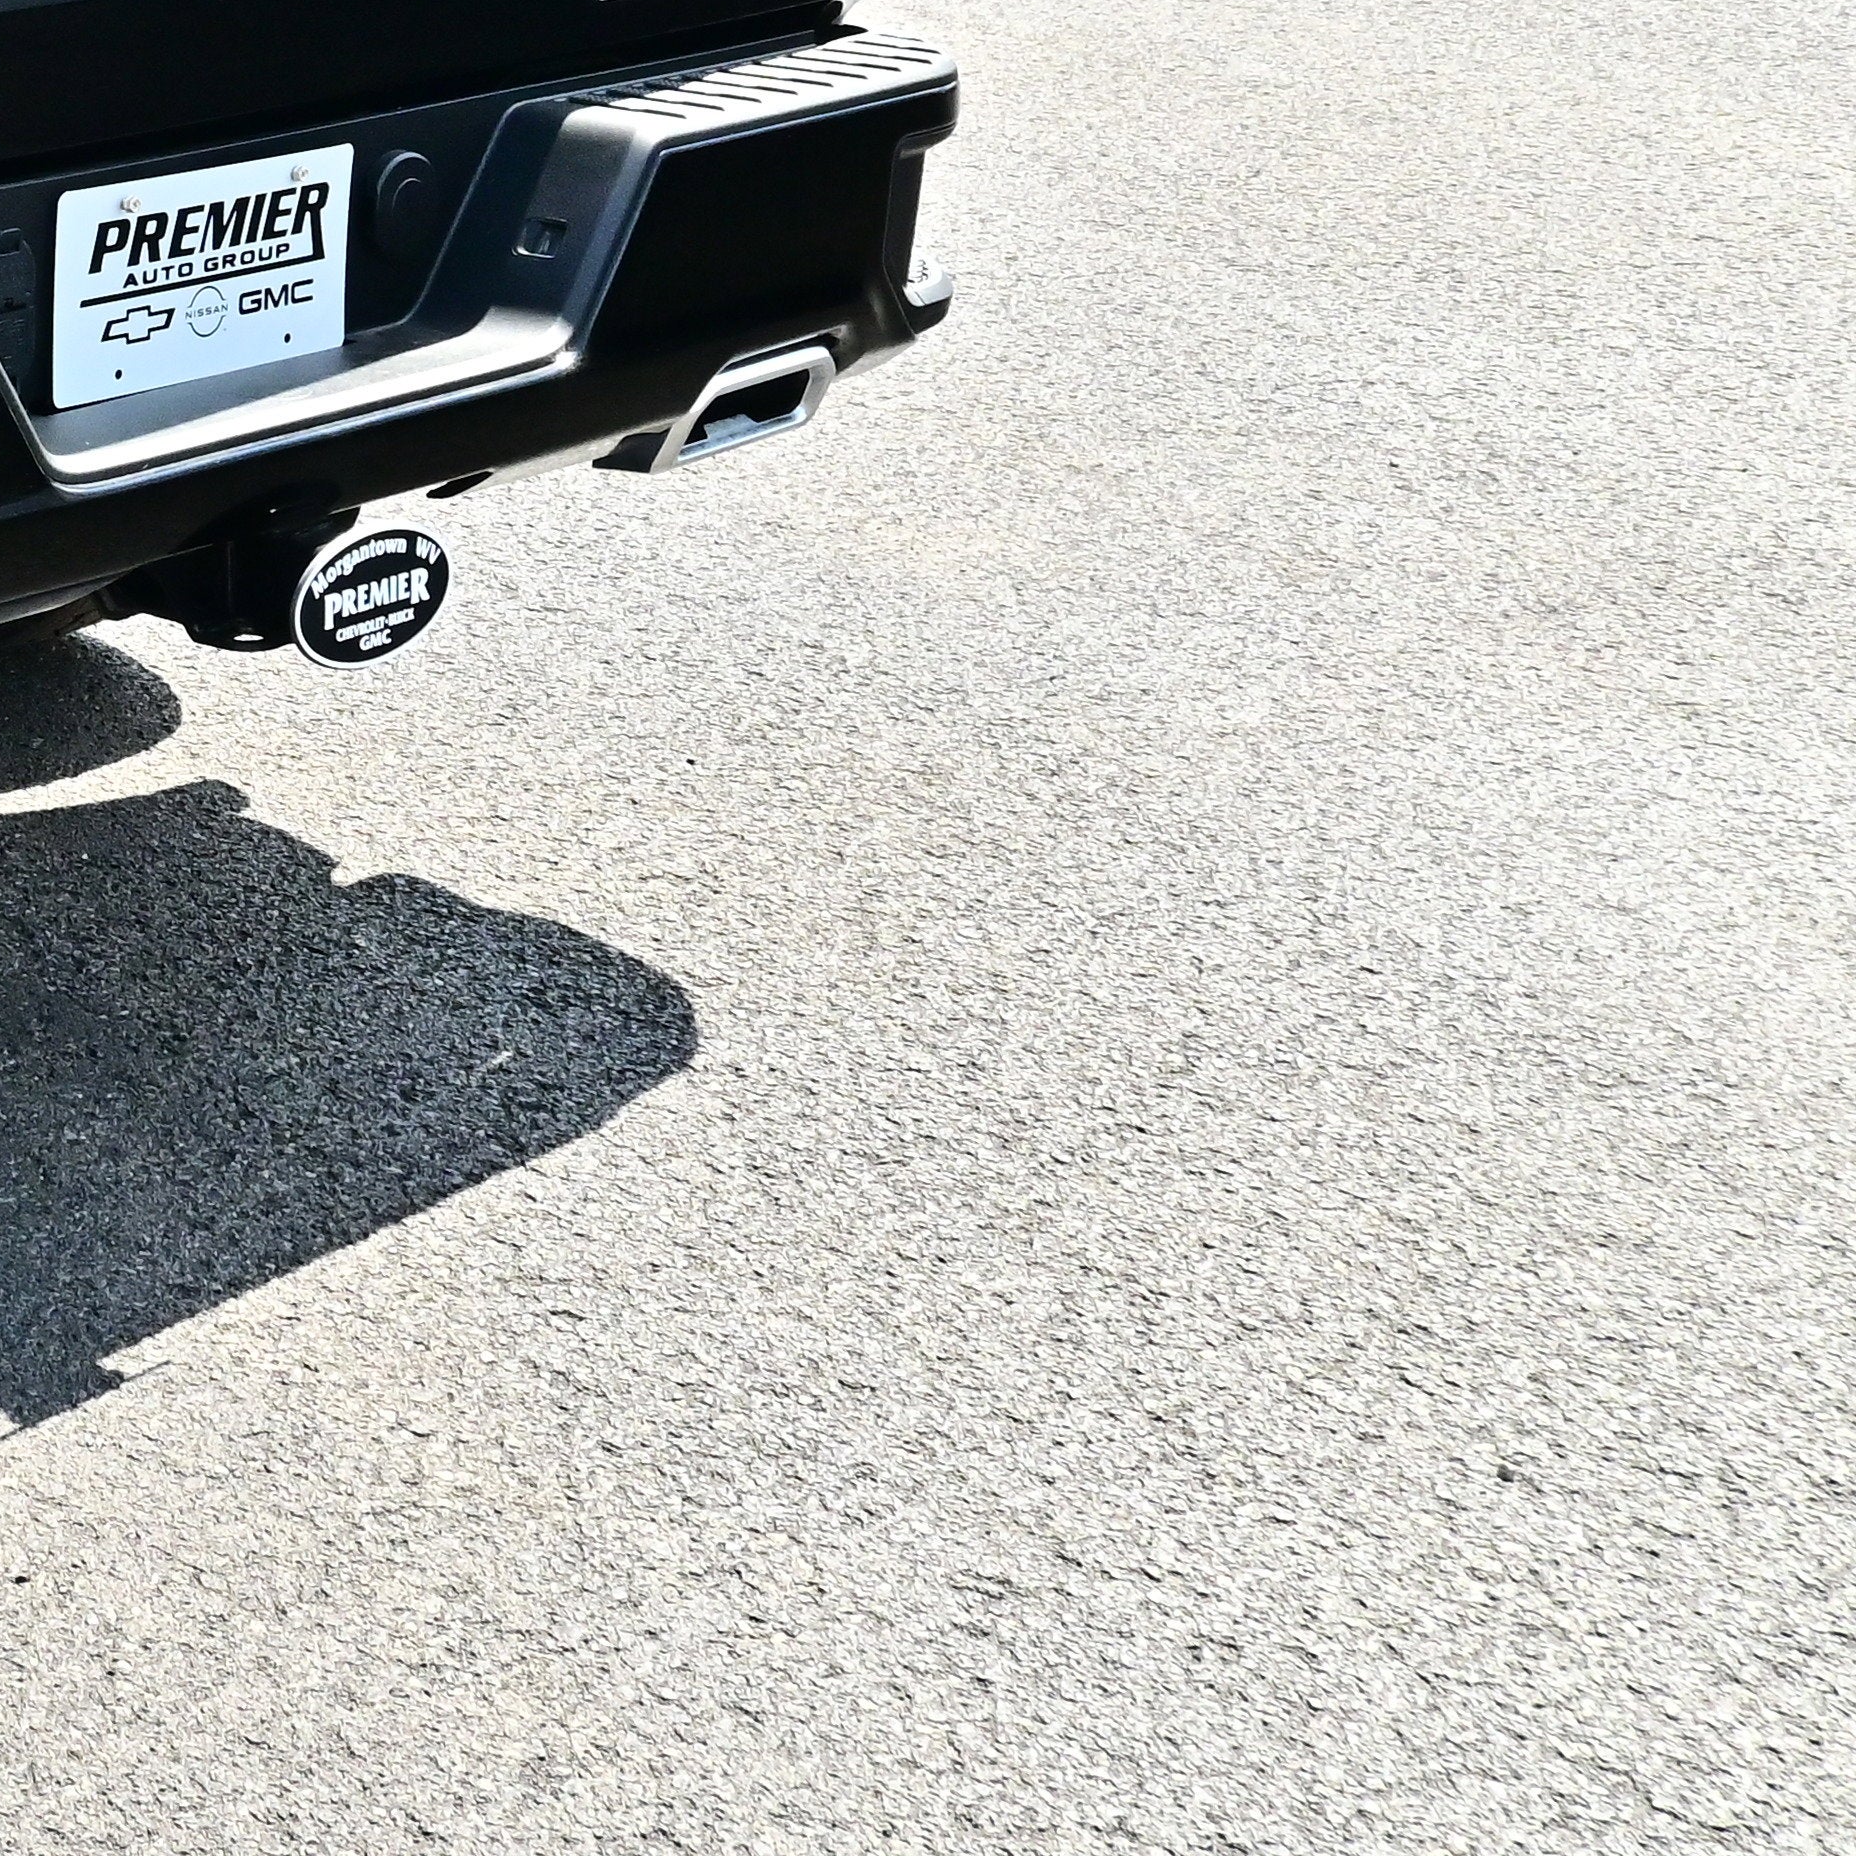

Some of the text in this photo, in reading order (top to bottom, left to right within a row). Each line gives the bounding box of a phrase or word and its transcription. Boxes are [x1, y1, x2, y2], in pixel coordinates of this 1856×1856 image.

[88, 181, 330, 275] PREMIER
[122, 242, 291, 289] AUTO GROUP
[184, 303, 229, 321] NISSAN
[238, 278, 314, 315] GMC
[415, 535, 442, 565] WV
[323, 567, 431, 631] PREMIER
[359, 629, 393, 652] GMC
